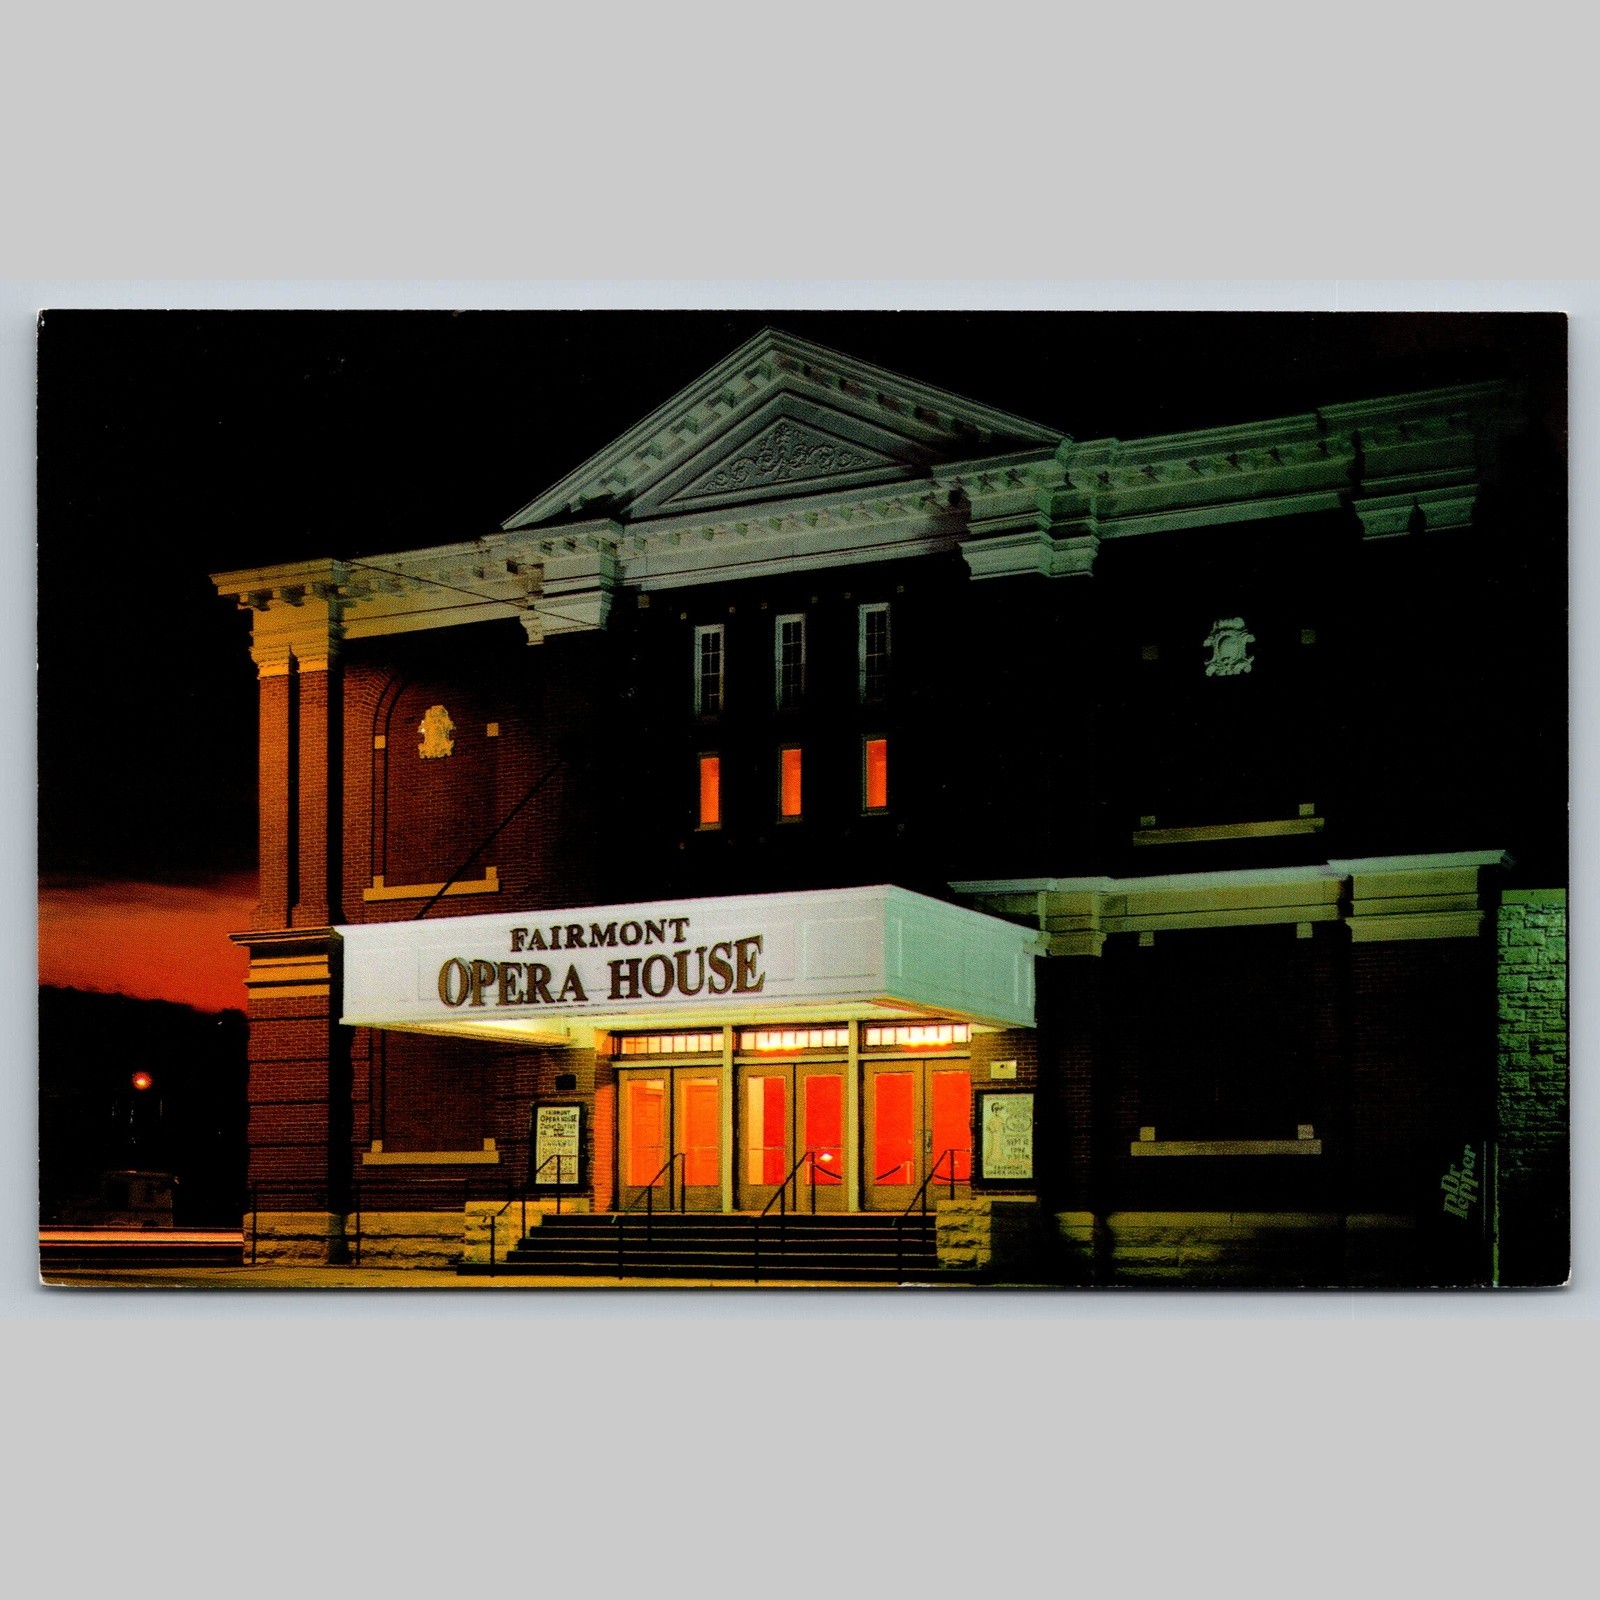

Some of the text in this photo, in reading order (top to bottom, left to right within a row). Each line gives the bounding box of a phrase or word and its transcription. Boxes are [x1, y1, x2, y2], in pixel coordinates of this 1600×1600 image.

[438, 934, 766, 1008] OPERA HOUSE
[510, 918, 690, 952] FAIRMONT
[1443, 1144, 1479, 1220] Pepper
